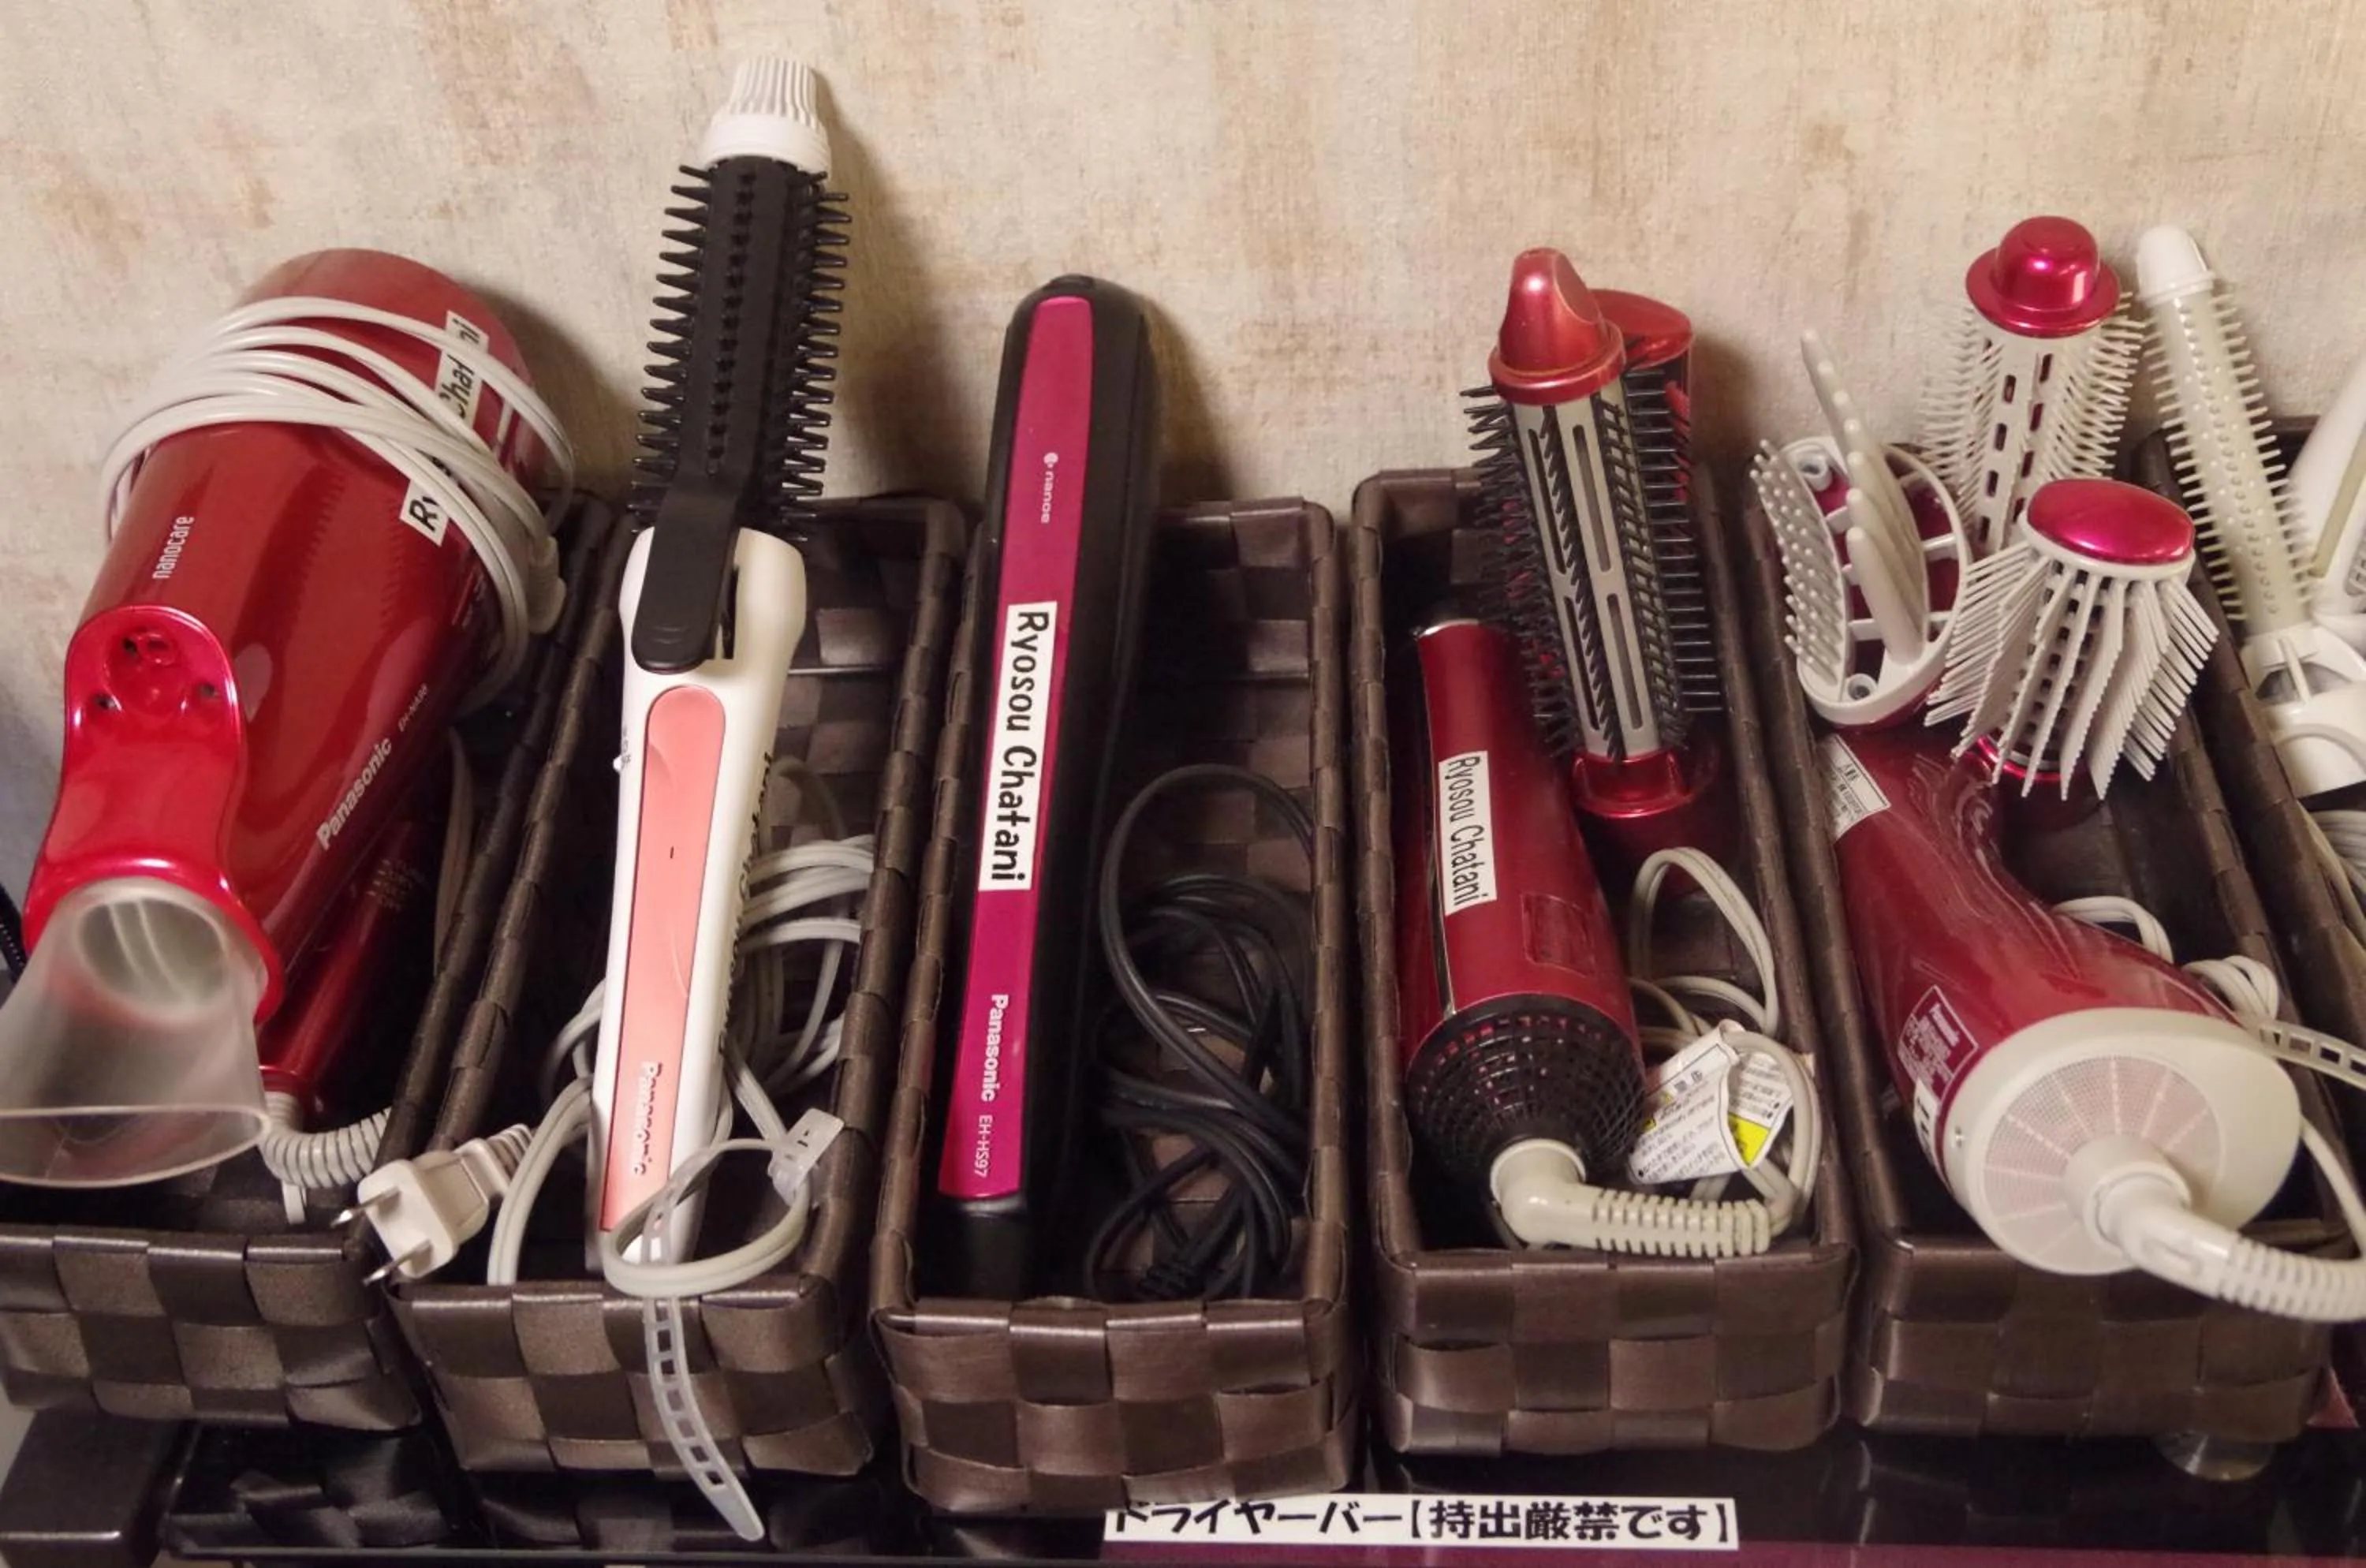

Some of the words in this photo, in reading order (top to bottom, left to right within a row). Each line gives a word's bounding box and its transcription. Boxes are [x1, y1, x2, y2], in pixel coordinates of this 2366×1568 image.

[152, 517, 195, 579] nanocare
[1006, 611, 1050, 731] Ryosou
[315, 737, 392, 851] Panasonic
[991, 746, 1037, 882] Chatani
[1445, 756, 1481, 823] Ryosou
[1450, 824, 1488, 906] Chatani
[980, 994, 1009, 1102] Panasonic
[632, 1062, 662, 1176] Panasonic
[974, 1114, 993, 1178] EH-HS97
